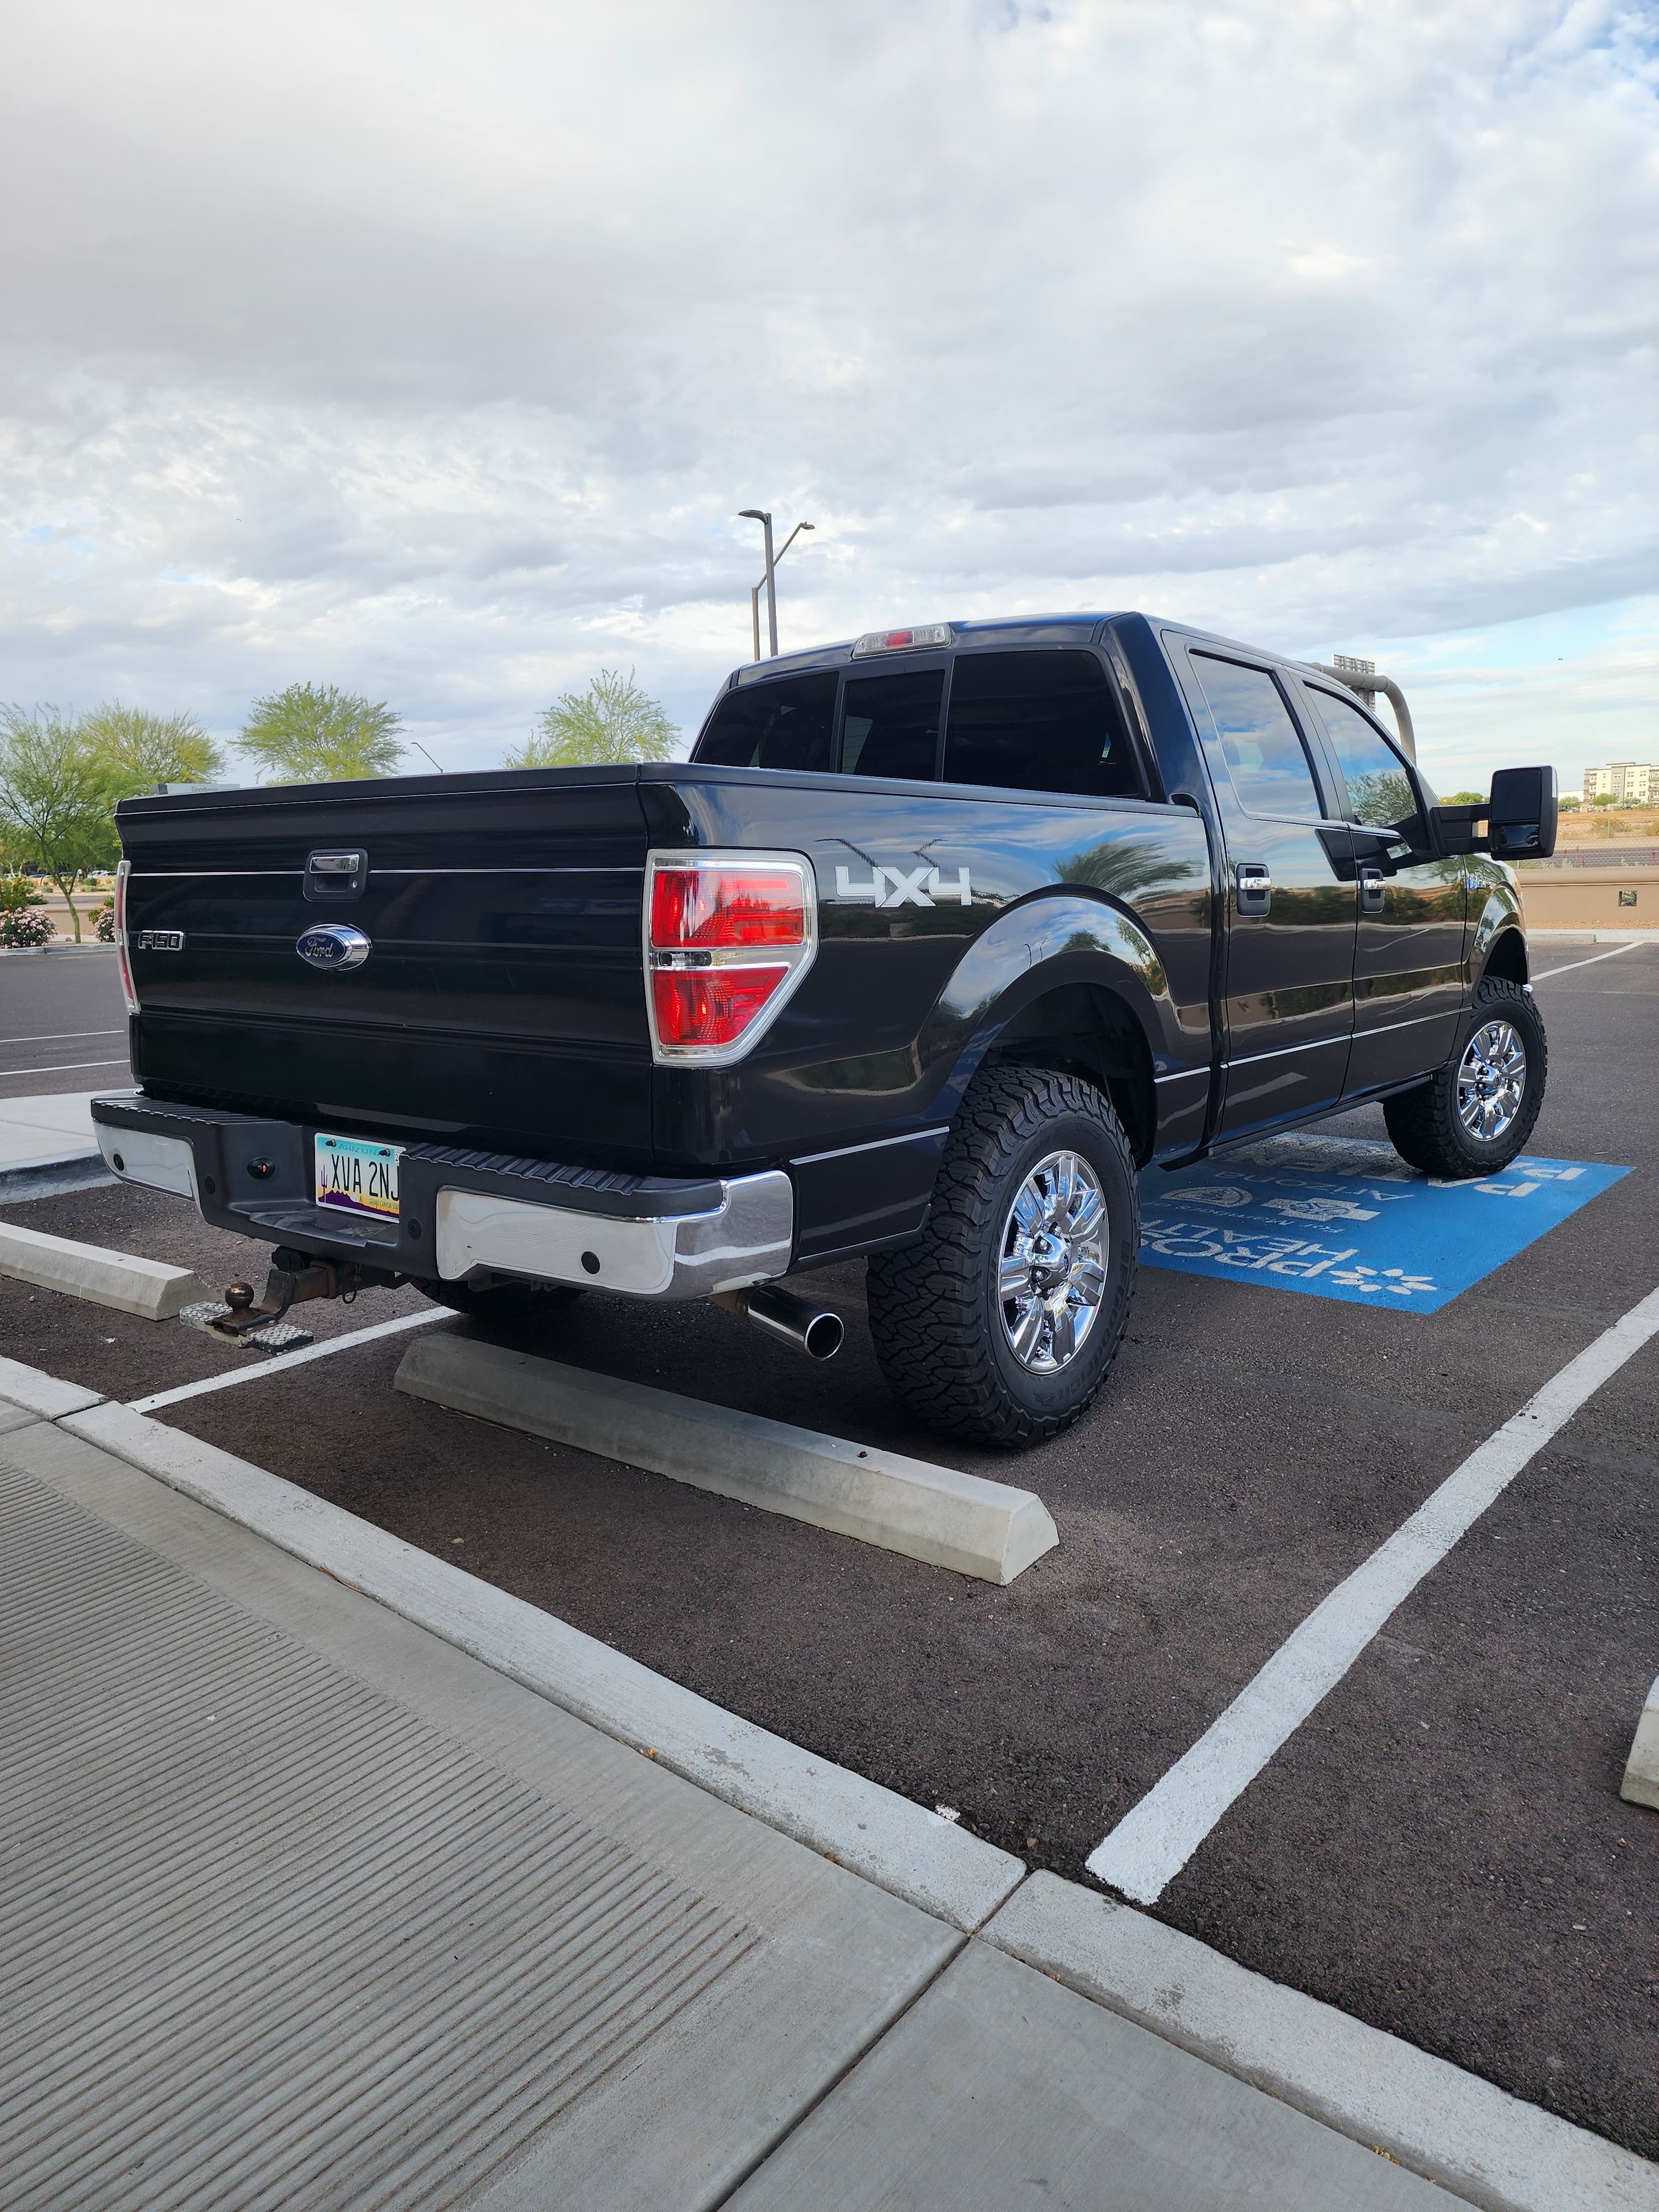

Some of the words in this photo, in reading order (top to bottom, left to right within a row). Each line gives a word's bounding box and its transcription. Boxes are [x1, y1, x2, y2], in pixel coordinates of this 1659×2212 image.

[138, 930, 184, 951] F-150
[305, 936, 334, 958] Ford
[338, 1144, 380, 1157] ARIZON
[331, 1154, 362, 1194] XVA
[369, 1162, 400, 1201] 2NJ
[1210, 1154, 1541, 1197] PATIEN
[1215, 1171, 1415, 1201] Arizona
[1300, 1224, 1345, 1233] For
